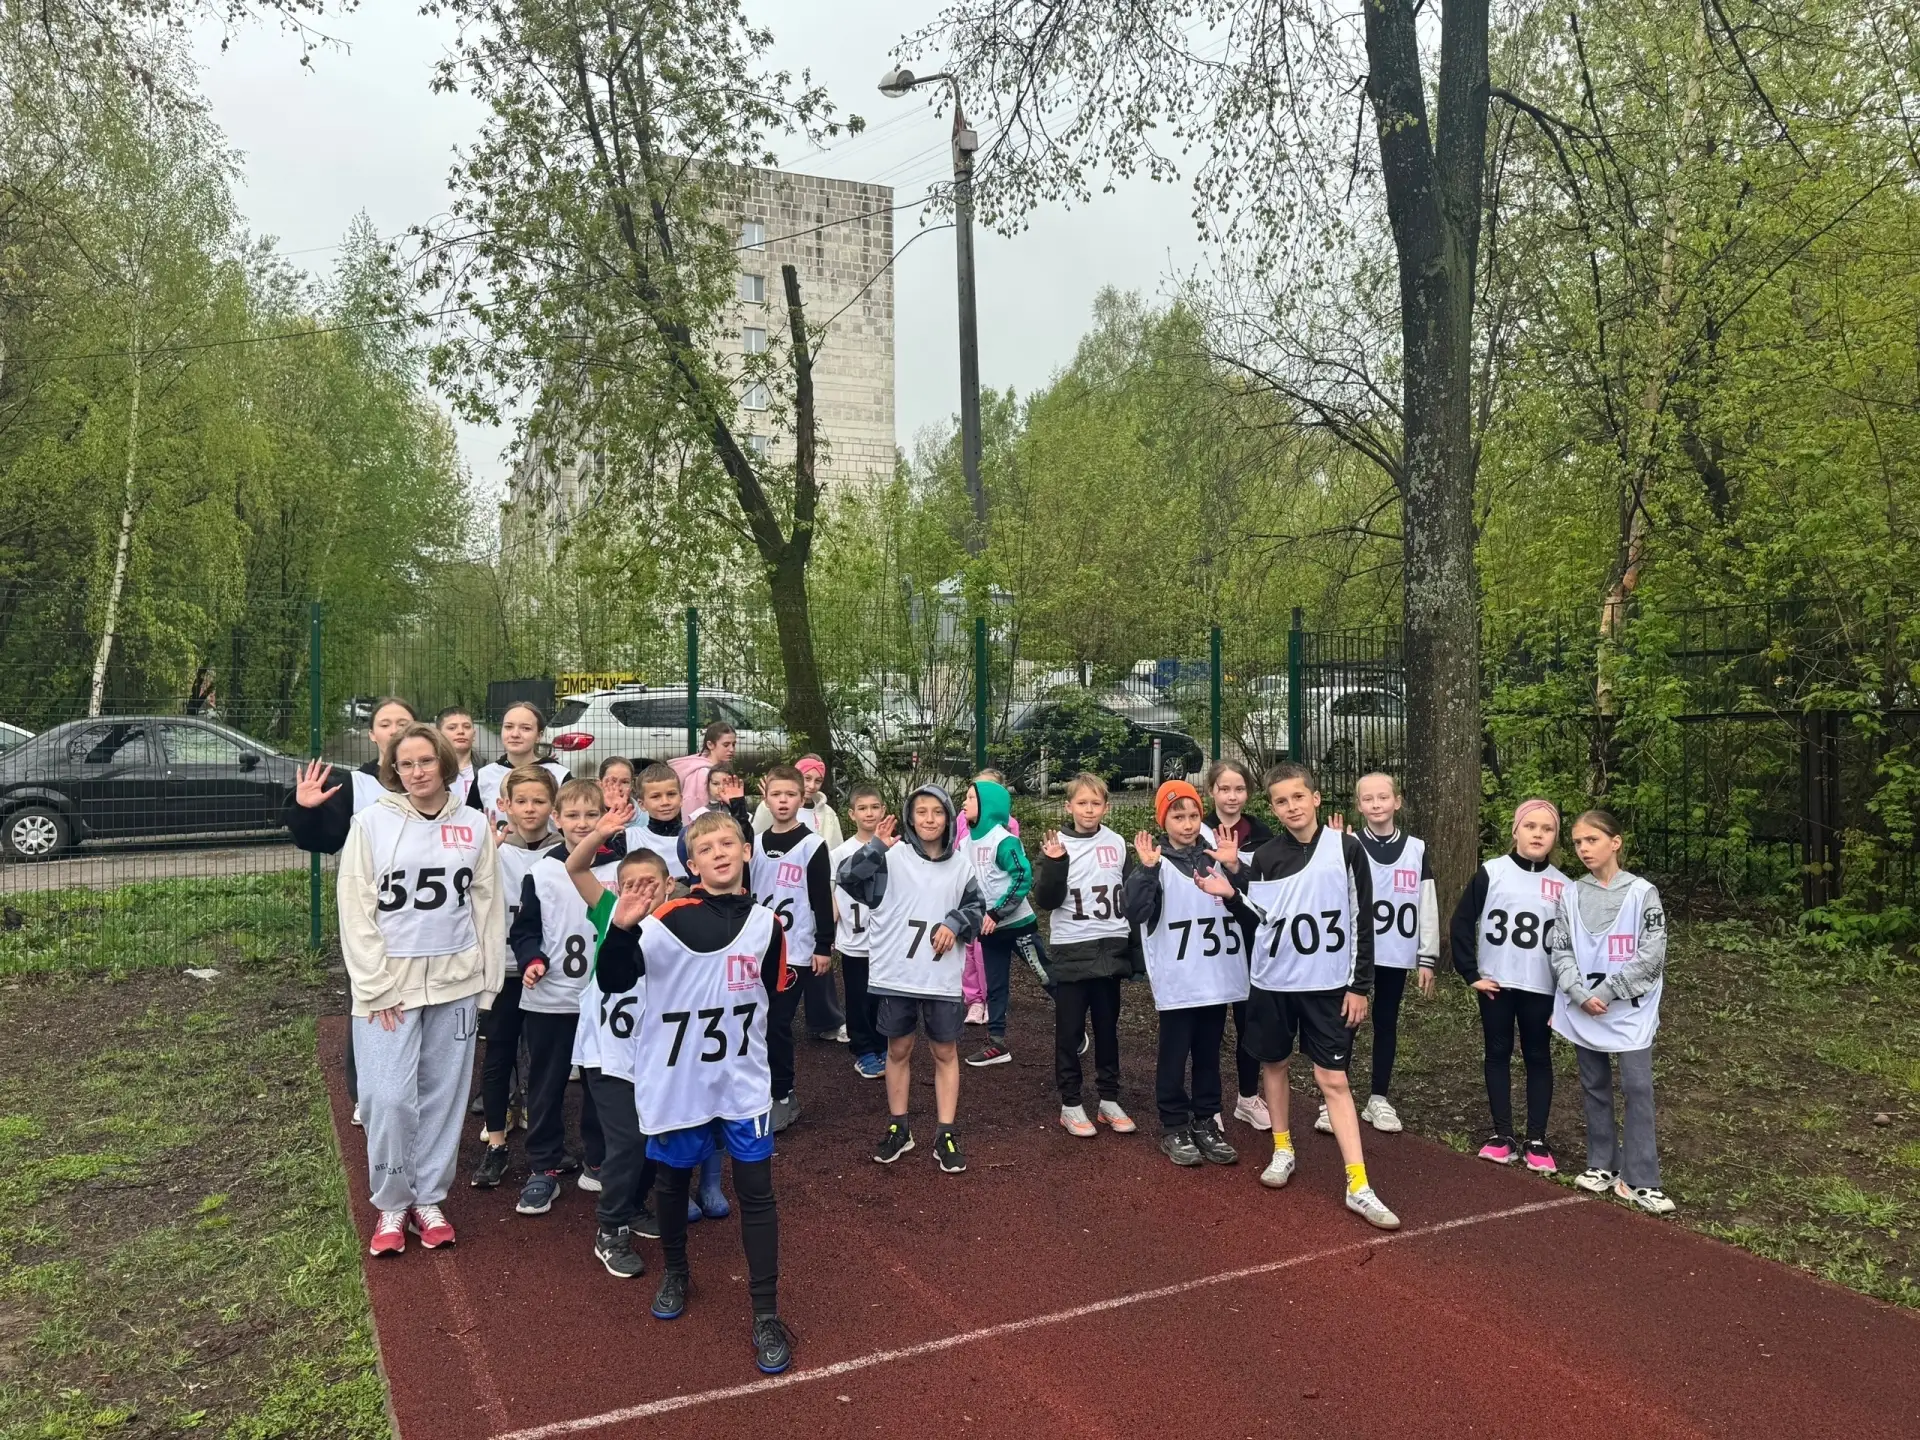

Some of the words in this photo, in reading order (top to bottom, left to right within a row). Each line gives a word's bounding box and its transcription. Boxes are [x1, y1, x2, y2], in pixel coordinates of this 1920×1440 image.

[441, 824, 473, 843] ГТО
[1096, 845, 1118, 863] ГТО
[777, 862, 803, 882] ГТО
[1394, 869, 1418, 888] ГТО
[378, 867, 473, 912] 559
[1168, 916, 1241, 961] 735
[727, 955, 760, 981] ГТО
[662, 1002, 758, 1067] 737
